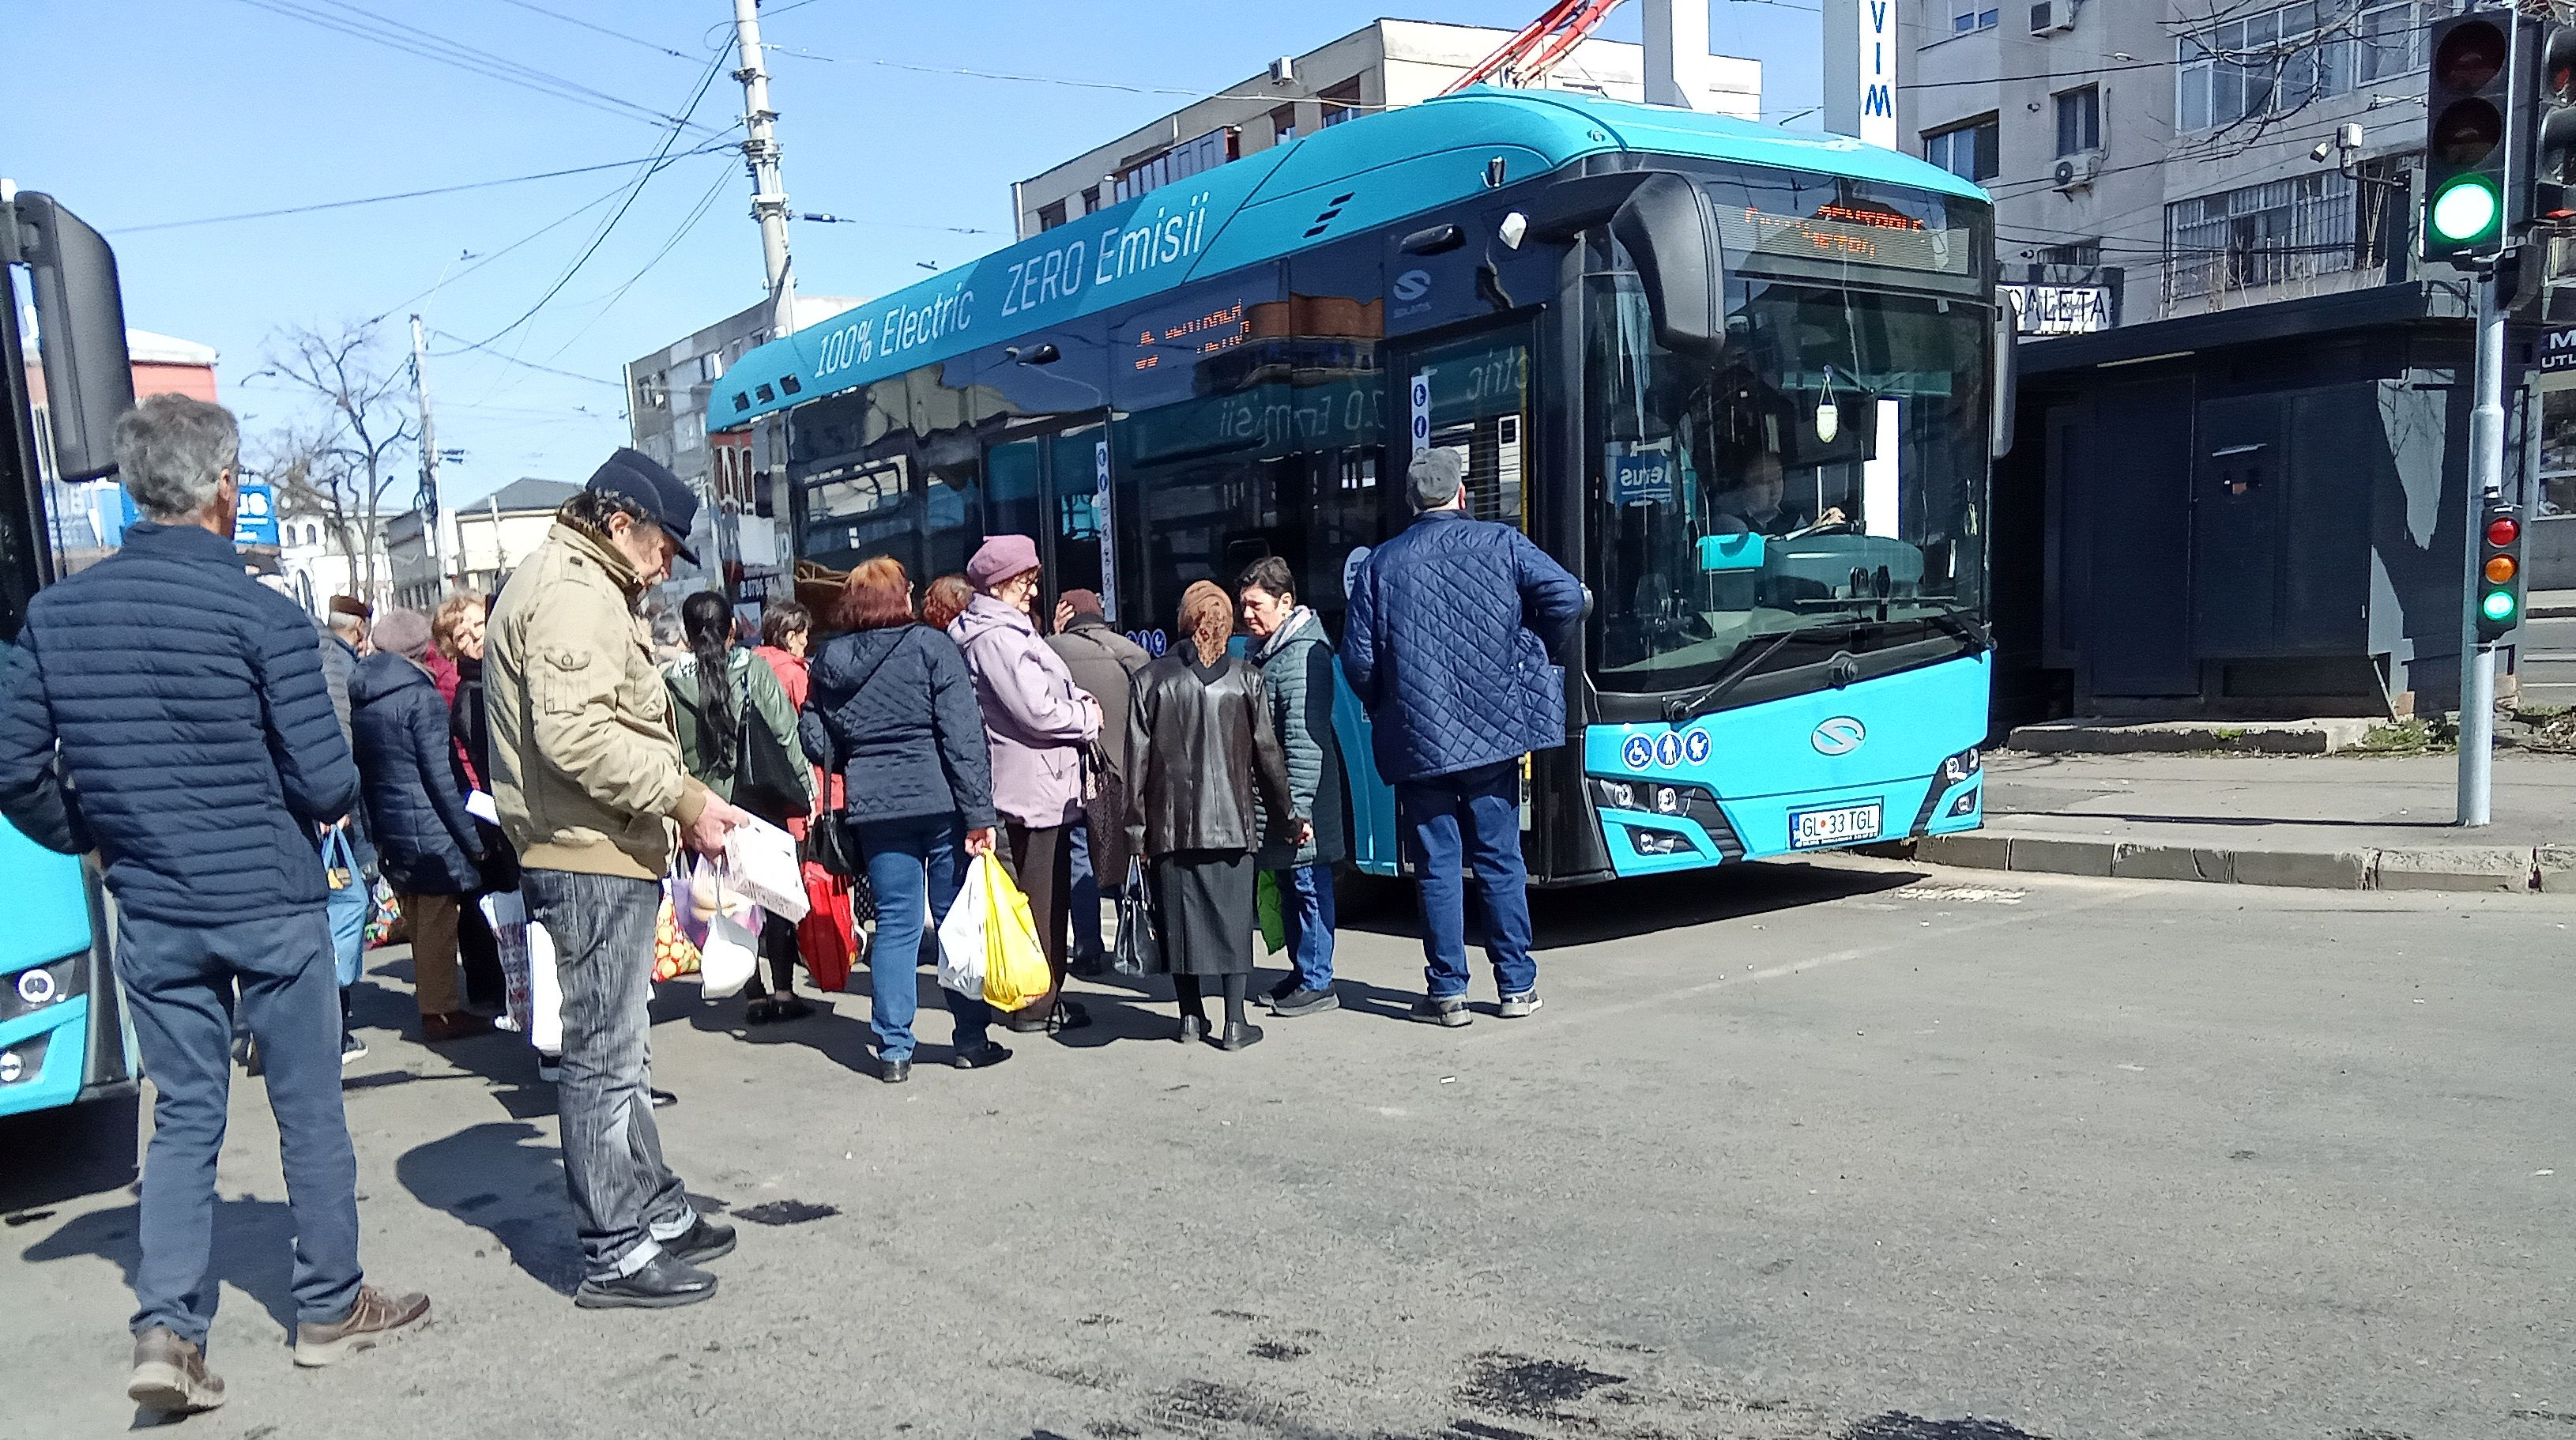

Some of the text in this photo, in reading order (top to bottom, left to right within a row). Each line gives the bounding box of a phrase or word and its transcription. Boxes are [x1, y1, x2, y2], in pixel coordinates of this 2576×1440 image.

[814, 191, 1210, 379] 100% Electric ZERO Emisii
[1802, 809, 1875, 838] GL 33 TGL
